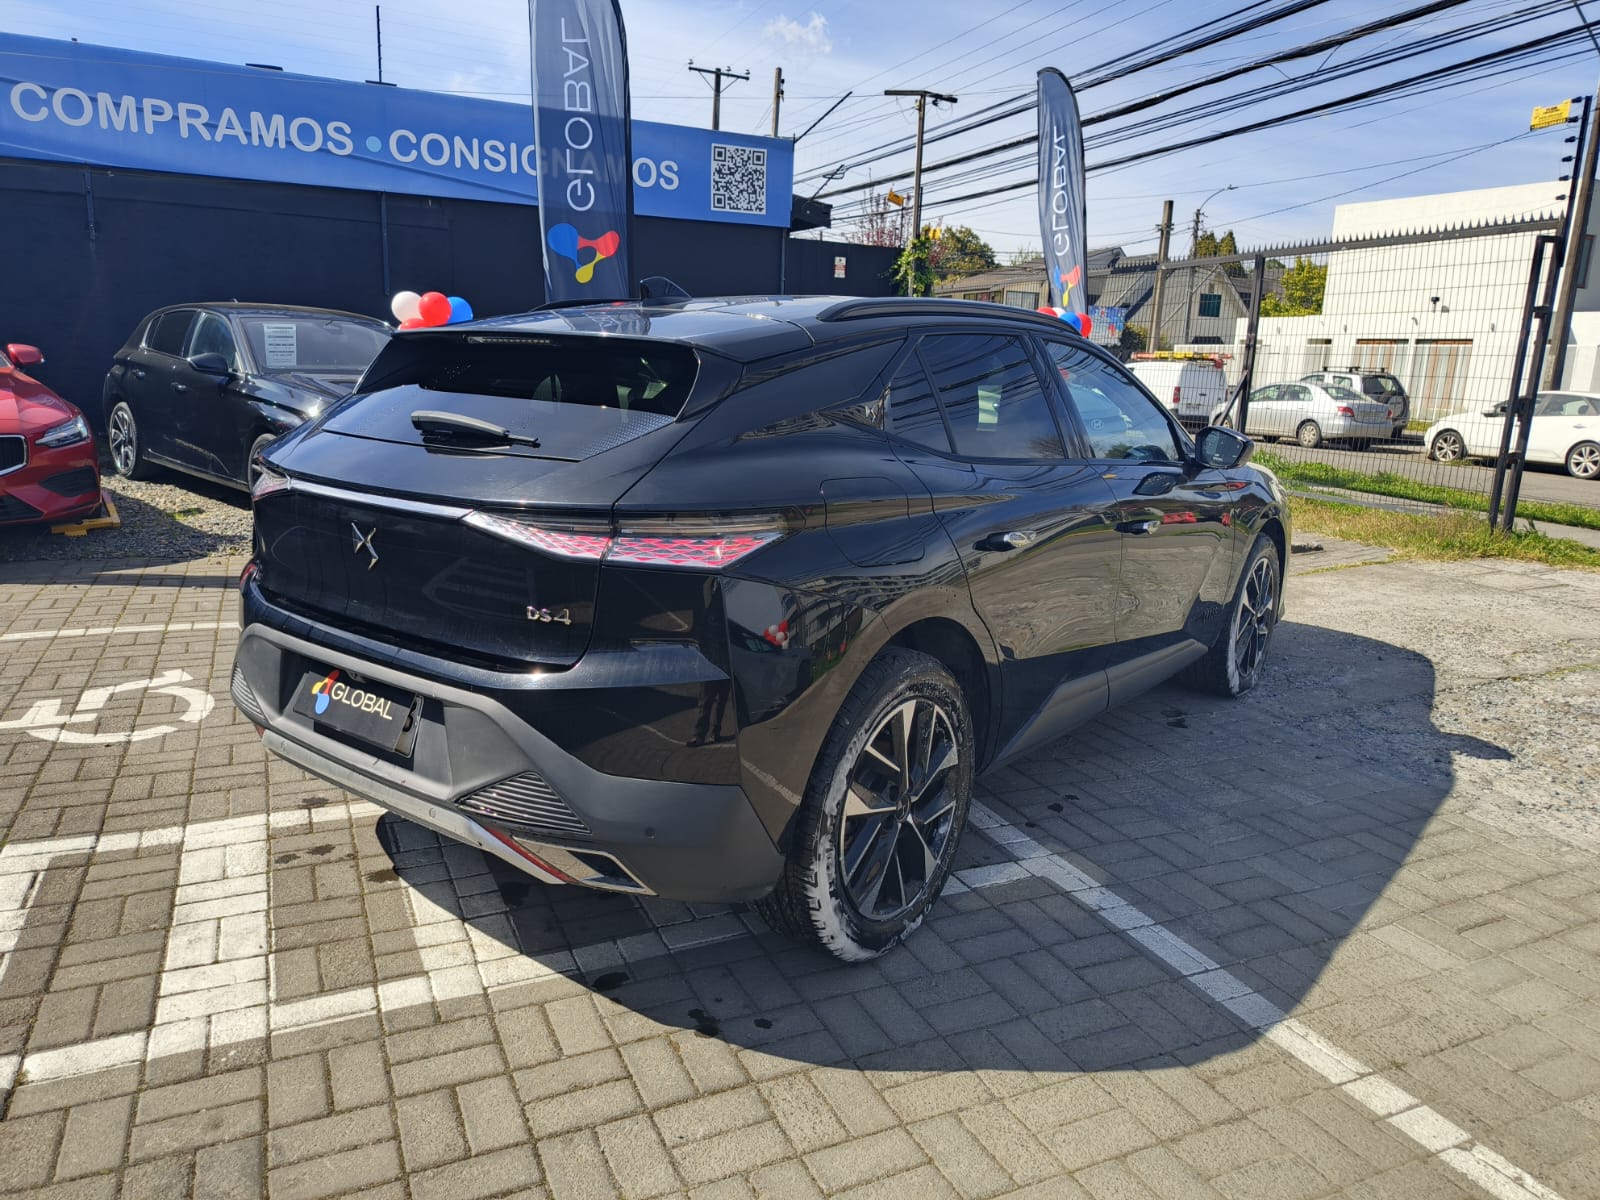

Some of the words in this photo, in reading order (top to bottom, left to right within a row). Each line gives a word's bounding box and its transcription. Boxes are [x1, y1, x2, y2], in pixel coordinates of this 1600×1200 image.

[10, 82, 354, 156] COMPRAMOS
[561, 17, 595, 211] GLOBAL
[1052, 126, 1069, 256] GLOBAL
[331, 682, 393, 720] GLOBAL
